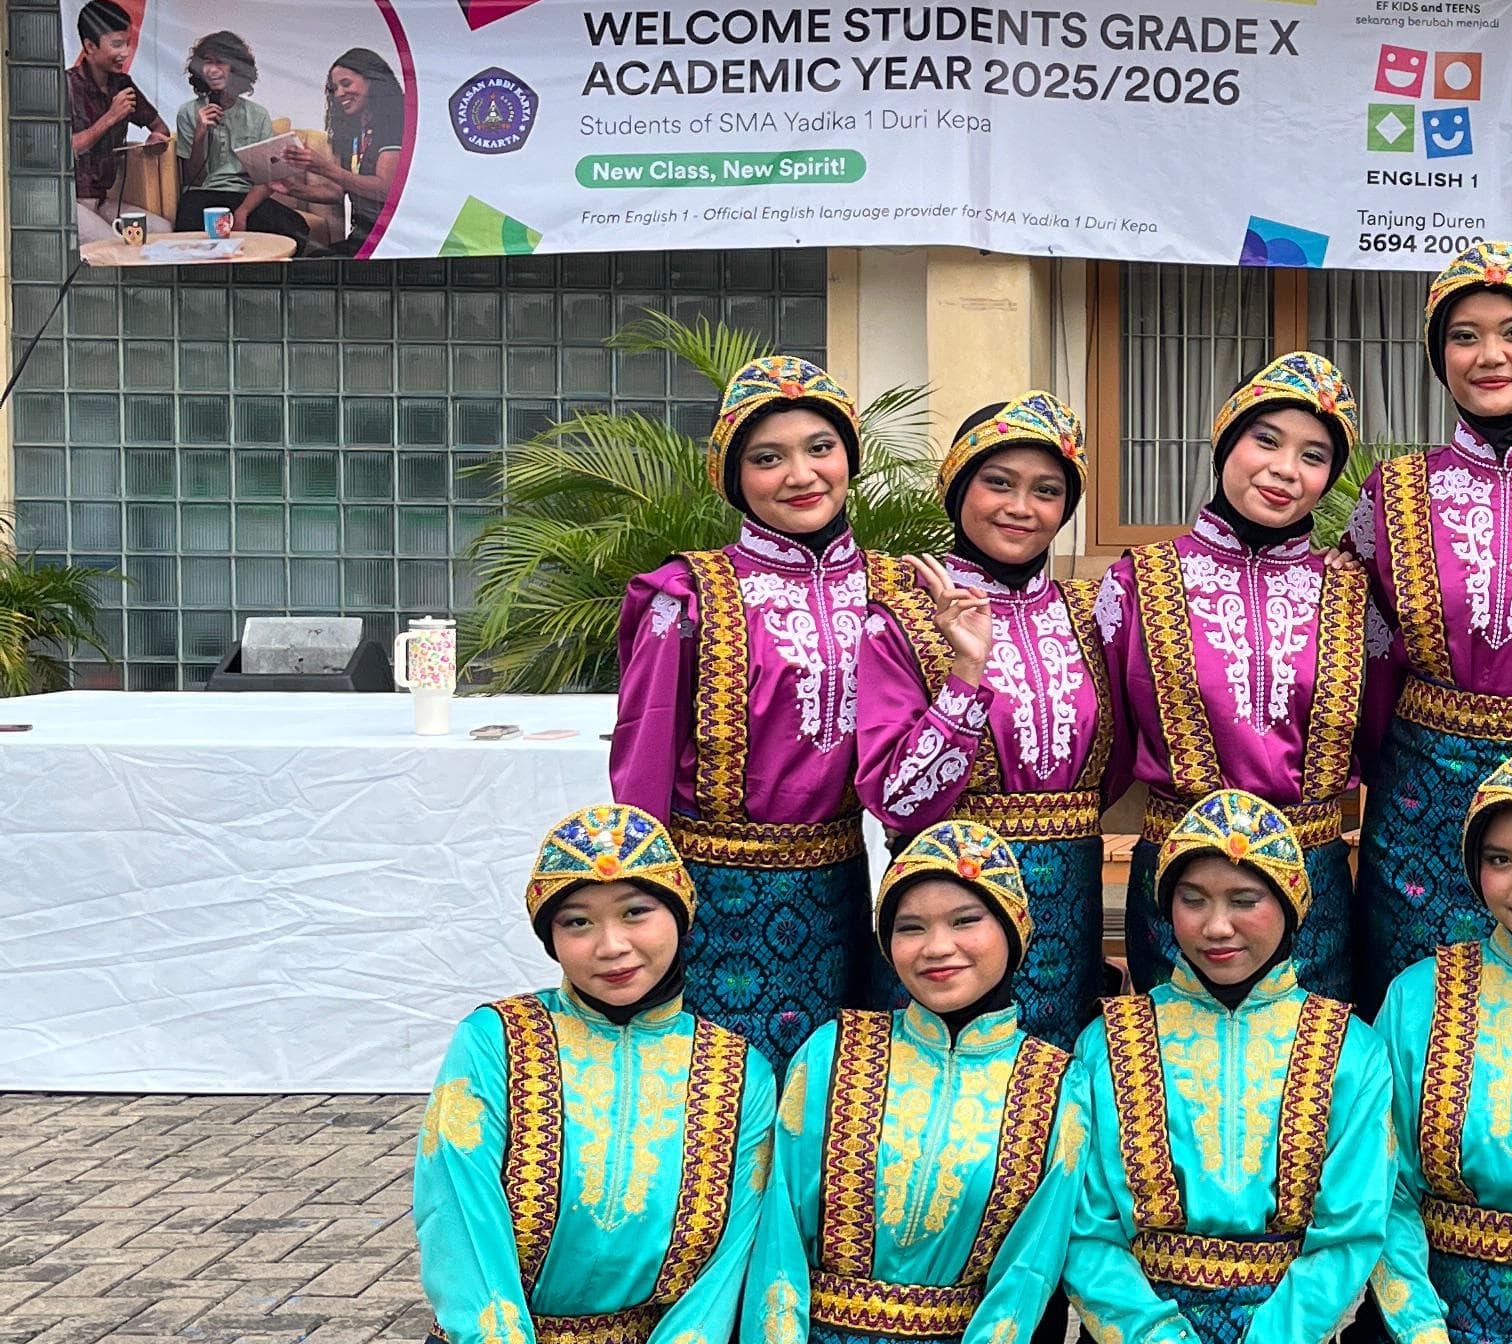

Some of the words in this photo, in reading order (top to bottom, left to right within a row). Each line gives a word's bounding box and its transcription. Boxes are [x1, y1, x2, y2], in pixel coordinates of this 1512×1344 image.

[1376, 1, 1389, 10] EF
[1392, 1, 1419, 12] KIDS
[1421, 3, 1443, 13] and
[1445, 3, 1480, 14] TEENS
[583, 9, 831, 46] WELCOME
[843, 6, 1087, 48] STUDENTS
[1100, 13, 1258, 54] GRADE
[1269, 19, 1300, 56] X
[1355, 15, 1405, 28] sekarang
[1408, 16, 1453, 27] berubah
[1456, 18, 1499, 30] menjadi
[581, 57, 841, 96] ACADEMIC
[851, 56, 972, 91] YEAR
[984, 59, 1240, 105] 2025/2026
[458, 81, 486, 124] YAYASAN
[488, 78, 516, 90] ABDI
[514, 88, 531, 122] KARYA
[580, 115, 681, 135] Students
[690, 113, 713, 133] of
[719, 112, 777, 133] SMA
[784, 111, 856, 132] Yadika
[864, 110, 872, 129] 1
[882, 109, 927, 129] Duri
[937, 109, 991, 133] Kepa
[468, 134, 520, 148] JAKARTA
[593, 162, 643, 180] New
[650, 161, 716, 182] Class,
[724, 160, 773, 178] New
[779, 157, 845, 180] Spirit!
[1367, 170, 1462, 188] ENGLISH
[1471, 174, 1477, 188] 1
[582, 211, 620, 224] From
[625, 209, 677, 226] English
[683, 209, 689, 222] 1
[703, 207, 757, 221] Official
[762, 206, 814, 222] English
[819, 206, 890, 221] language
[893, 203, 958, 220] provider
[962, 204, 982, 219] for
[984, 208, 1016, 223] SMA
[1022, 212, 1069, 228] Yadika
[1075, 216, 1081, 228] 1
[1085, 216, 1117, 230] Duri
[1121, 218, 1157, 234] Kepa
[1357, 210, 1425, 231] Tanjung
[1433, 212, 1485, 229] Duren
[1359, 233, 1417, 252] 5694
